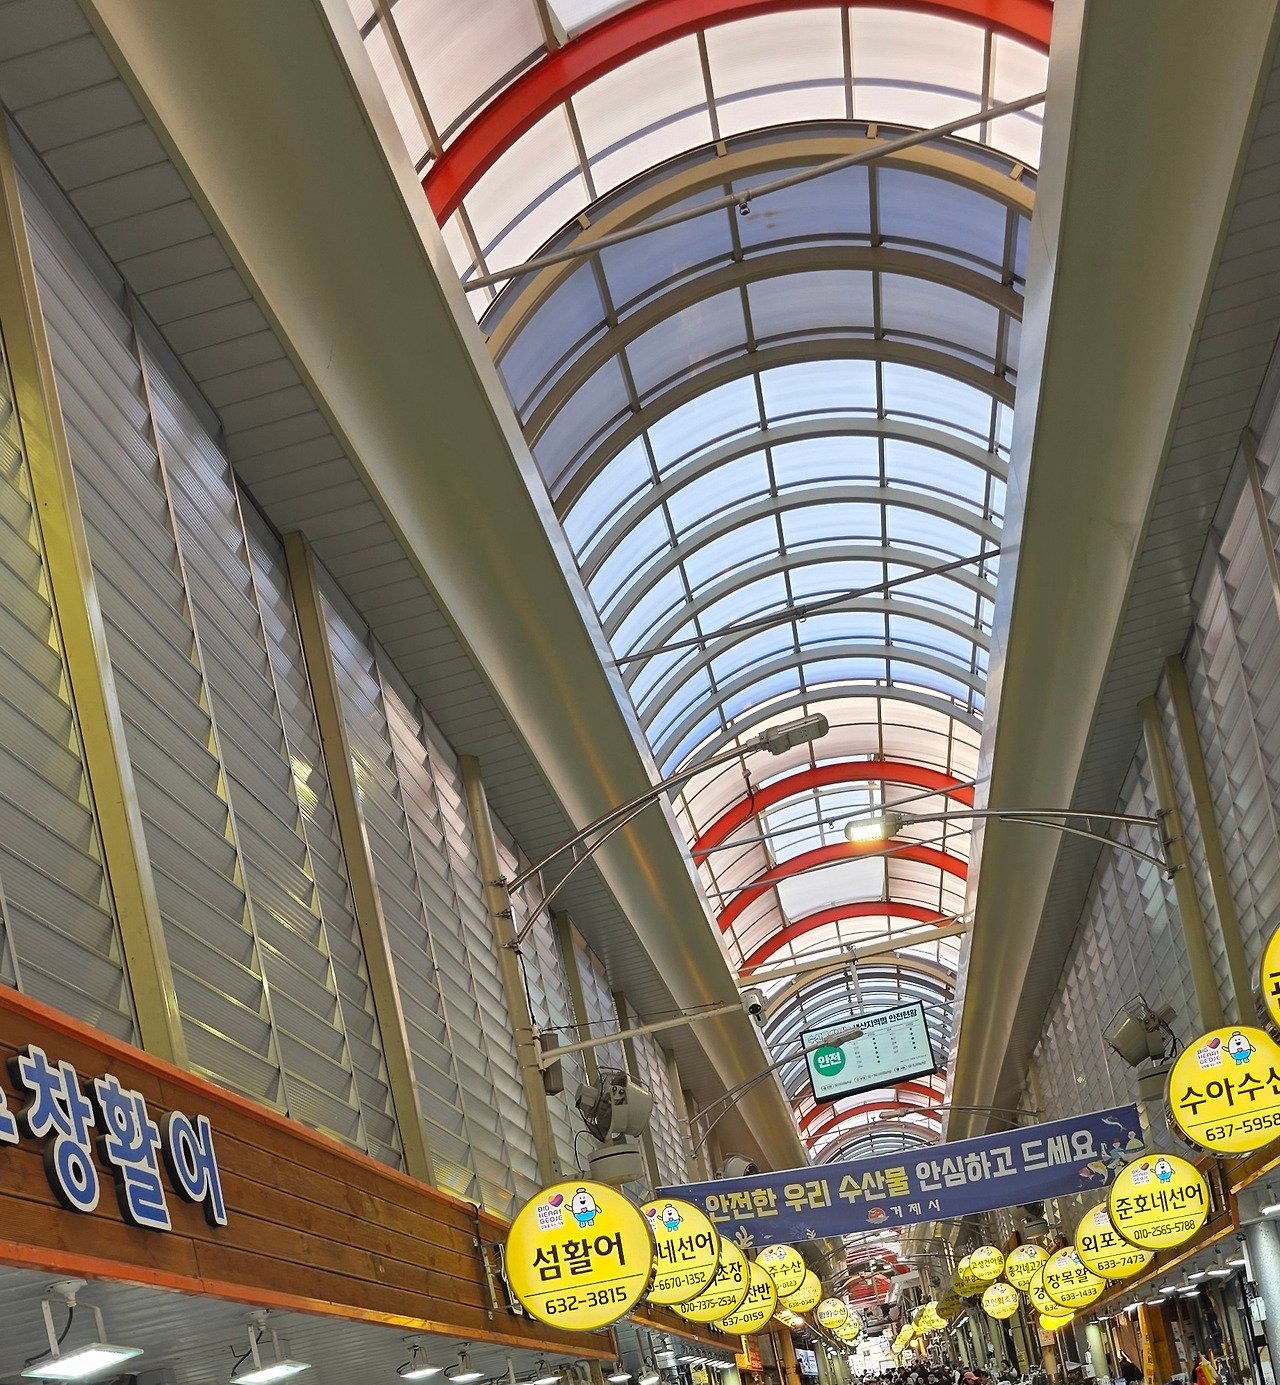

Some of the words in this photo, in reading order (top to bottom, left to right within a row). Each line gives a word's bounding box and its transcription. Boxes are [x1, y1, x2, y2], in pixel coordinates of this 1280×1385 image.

[817, 1052, 842, 1069] 안전
[0, 1044, 228, 1231] 창활어
[705, 1187, 778, 1223] 안전한
[784, 1179, 831, 1212] 우리
[839, 1166, 910, 1204] 수산물
[915, 1146, 1018, 1192] 안심하고
[1021, 1129, 1098, 1173] 드세요
[1116, 1183, 1204, 1220] 준호네선어
[1133, 1219, 1196, 1240] 010-2565-5788
[532, 1232, 626, 1281] 섬활어
[1097, 1253, 1145, 1271] 633-7473
[545, 1285, 627, 1315] 632-3815
[681, 1295, 737, 1314] 070-7375-2534
[1060, 1287, 1097, 1302] 633-1433
[722, 1310, 764, 1327] 637-0159
